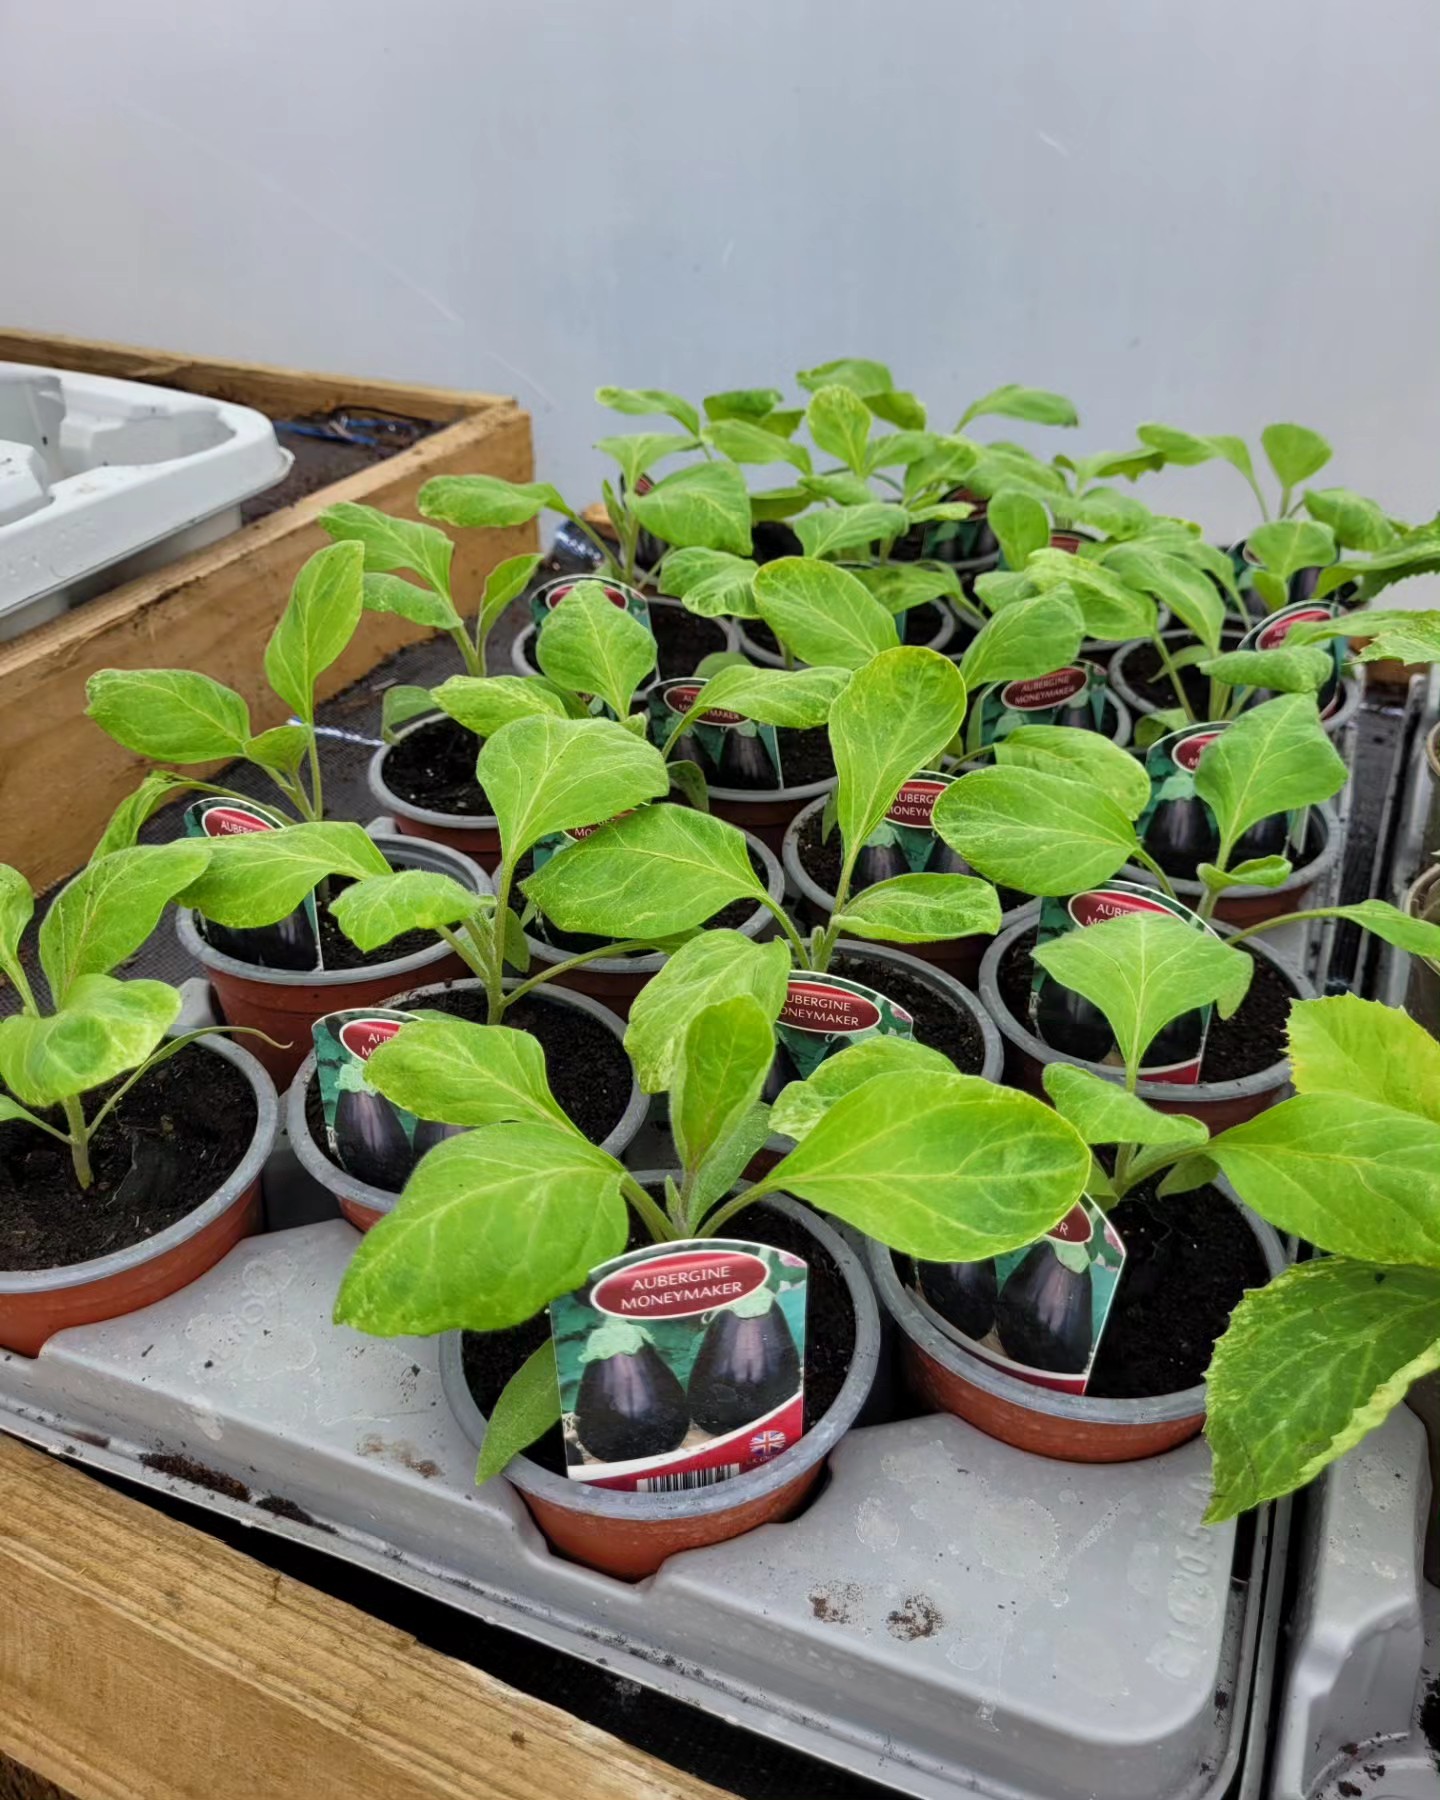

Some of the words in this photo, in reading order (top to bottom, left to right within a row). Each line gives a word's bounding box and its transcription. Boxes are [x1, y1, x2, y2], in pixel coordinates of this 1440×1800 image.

[785, 994, 852, 1012] UBERGINE
[780, 1007, 859, 1026] ONEYMAKER
[631, 1265, 731, 1291] AUBERGINE
[621, 1281, 743, 1310] MONEYMAKER
